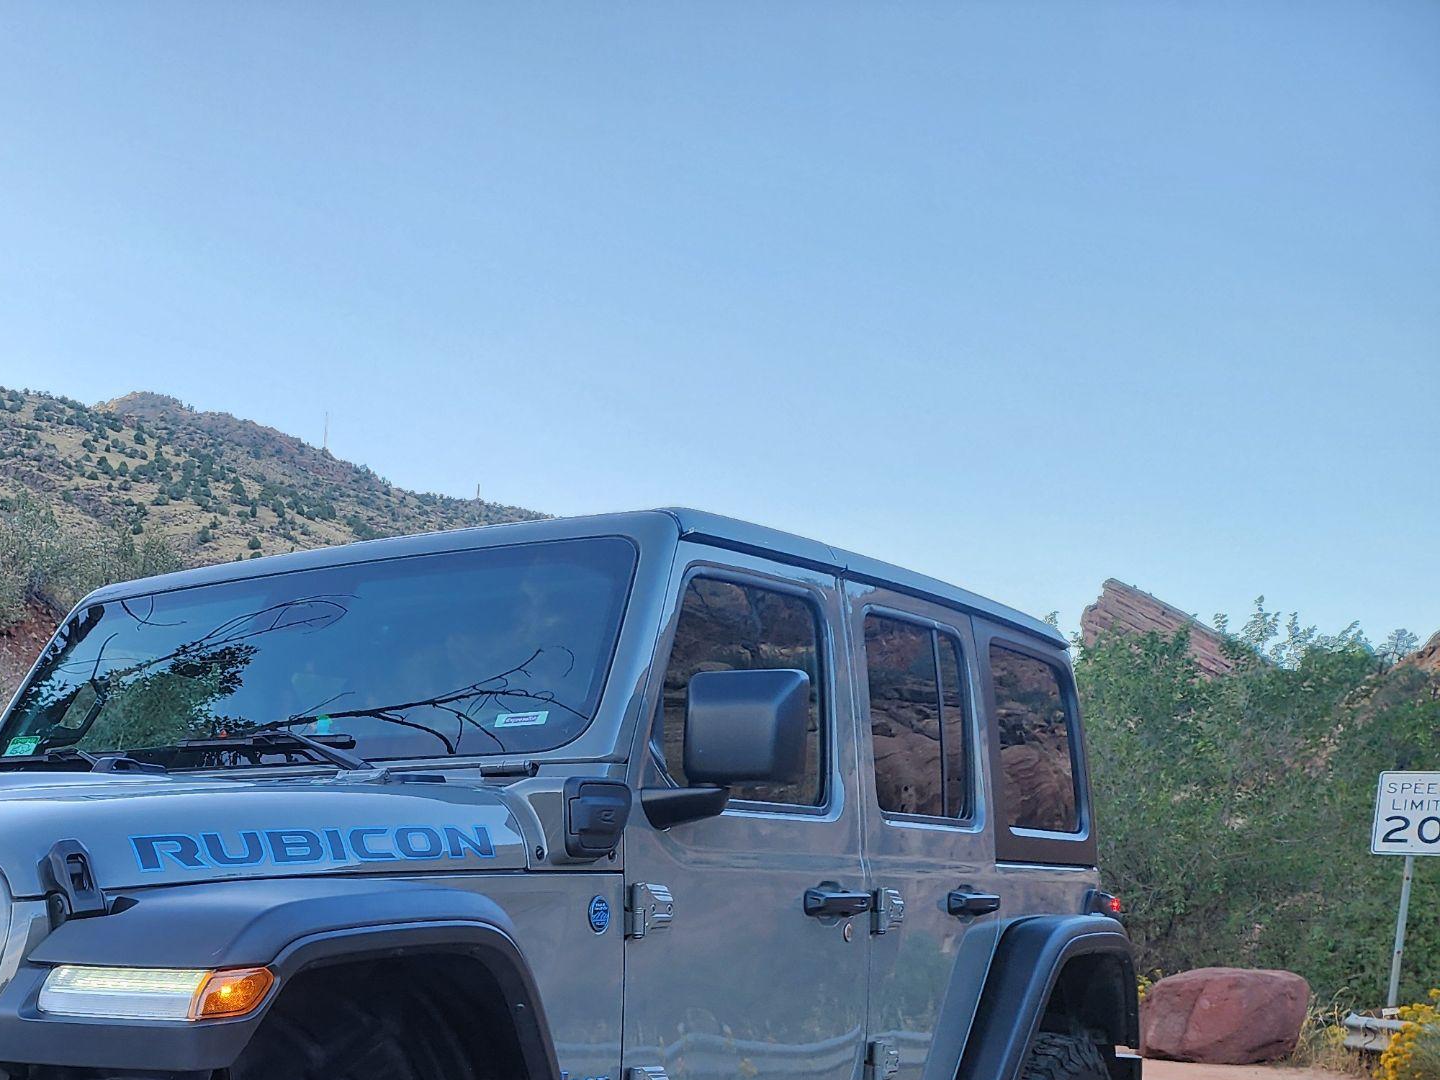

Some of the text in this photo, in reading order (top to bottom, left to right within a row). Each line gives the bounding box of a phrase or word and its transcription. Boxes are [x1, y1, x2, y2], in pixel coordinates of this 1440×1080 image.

[1387, 782, 1438, 795] SPEE
[1382, 815, 1440, 844] 20
[129, 825, 496, 873] RUBICON
